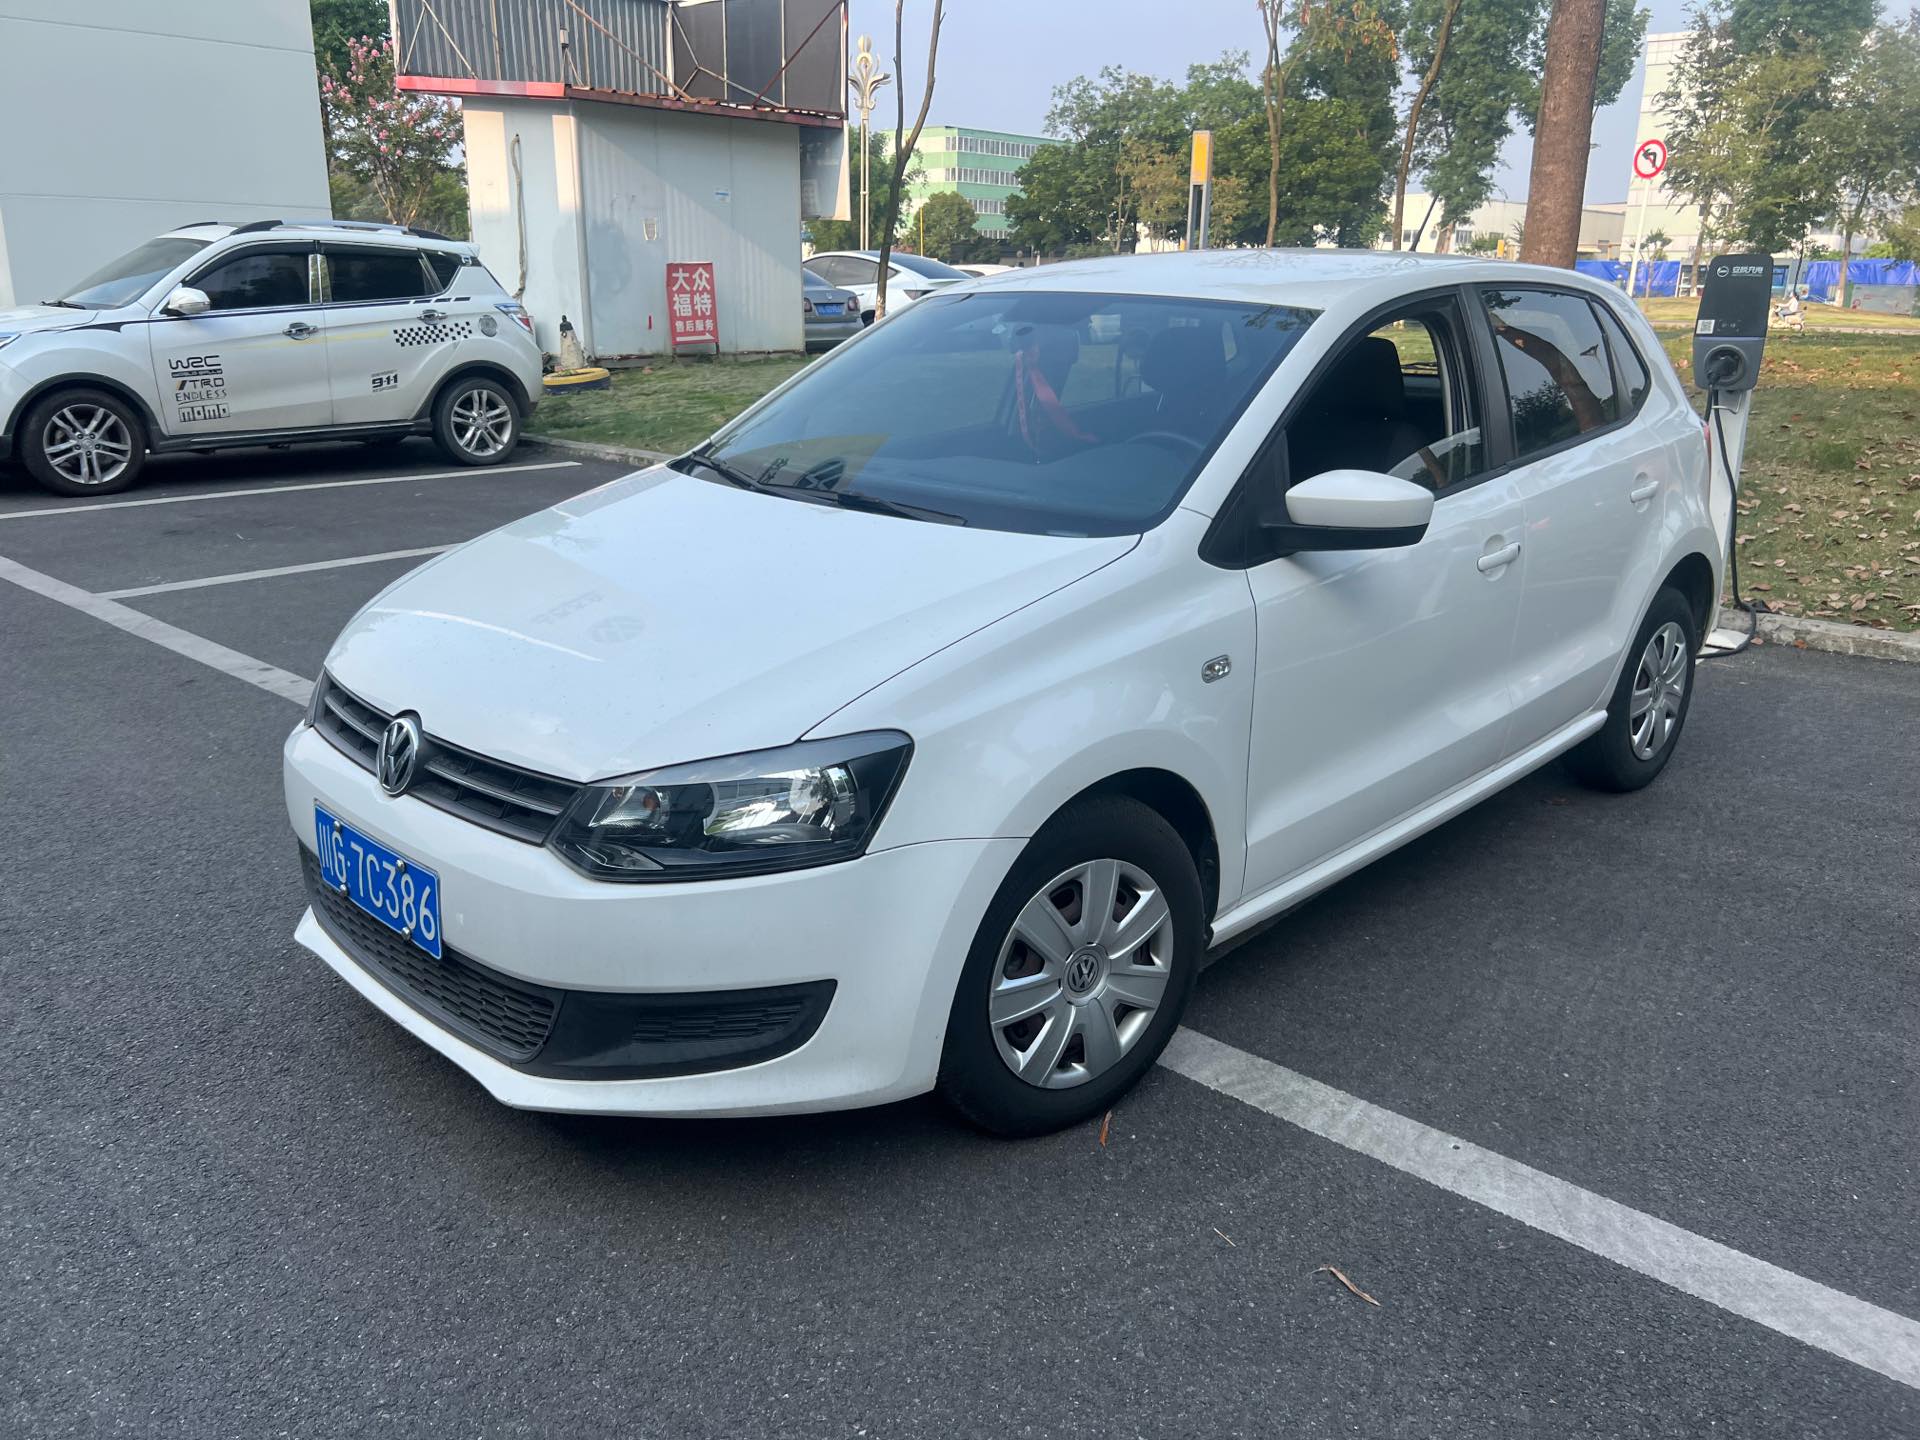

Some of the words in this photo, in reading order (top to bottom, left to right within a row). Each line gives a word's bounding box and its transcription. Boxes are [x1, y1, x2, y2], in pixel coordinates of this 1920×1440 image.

[672, 267, 711, 291] 大众
[673, 292, 712, 317] 福特
[675, 319, 714, 332] 售后服务
[168, 355, 222, 370] WRC
[175, 389, 227, 402] ENDLESS
